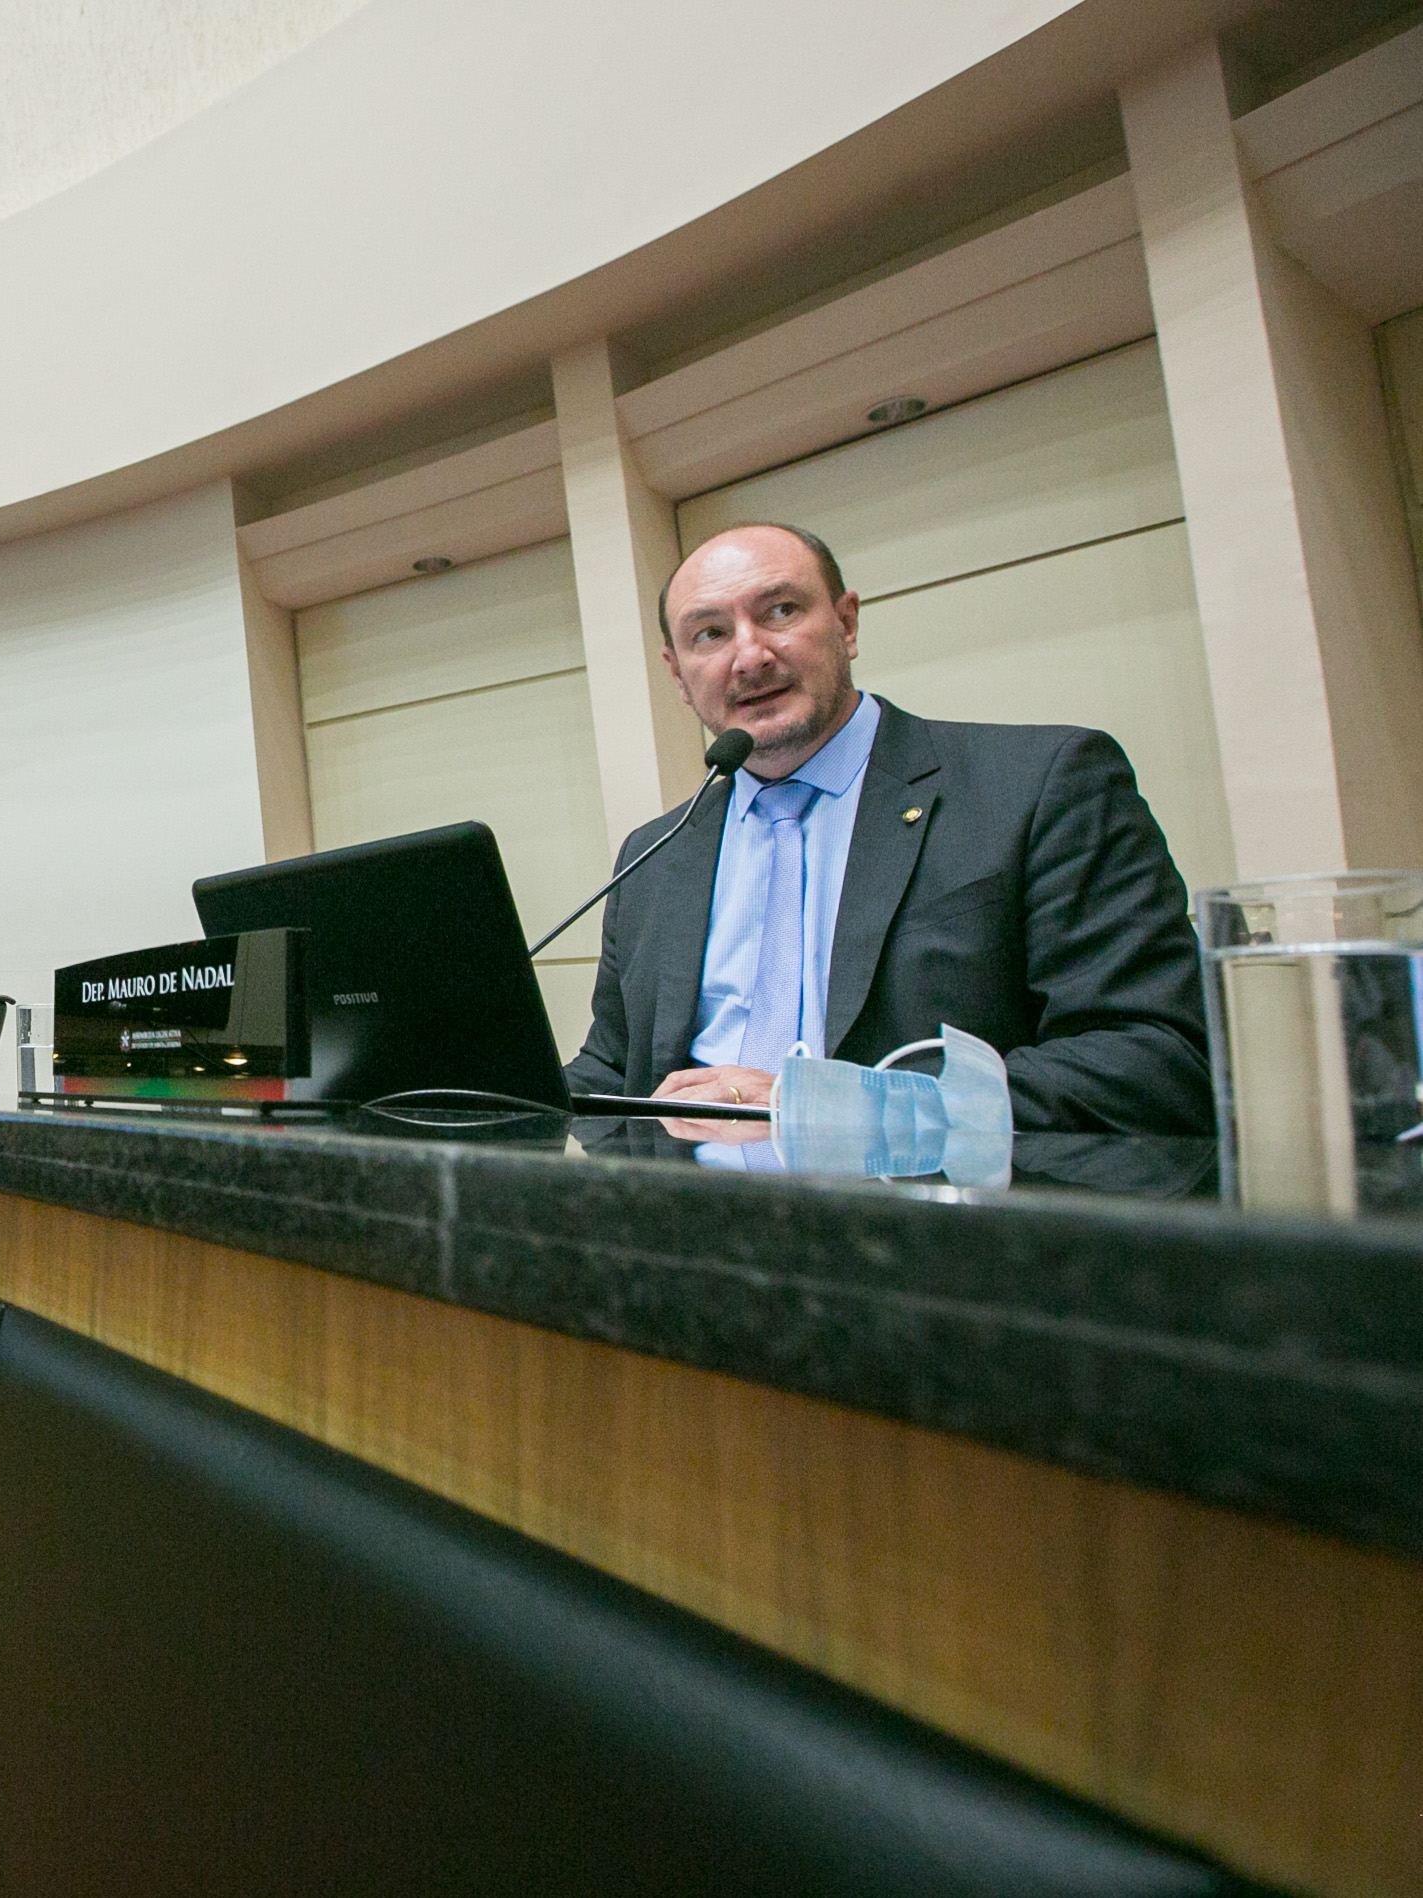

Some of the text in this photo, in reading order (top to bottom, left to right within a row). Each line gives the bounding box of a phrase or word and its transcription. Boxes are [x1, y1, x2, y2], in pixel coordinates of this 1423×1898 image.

[82, 963, 235, 1003] DEP. MAURO DE NADAL
[333, 991, 379, 1006] POSITIVO
